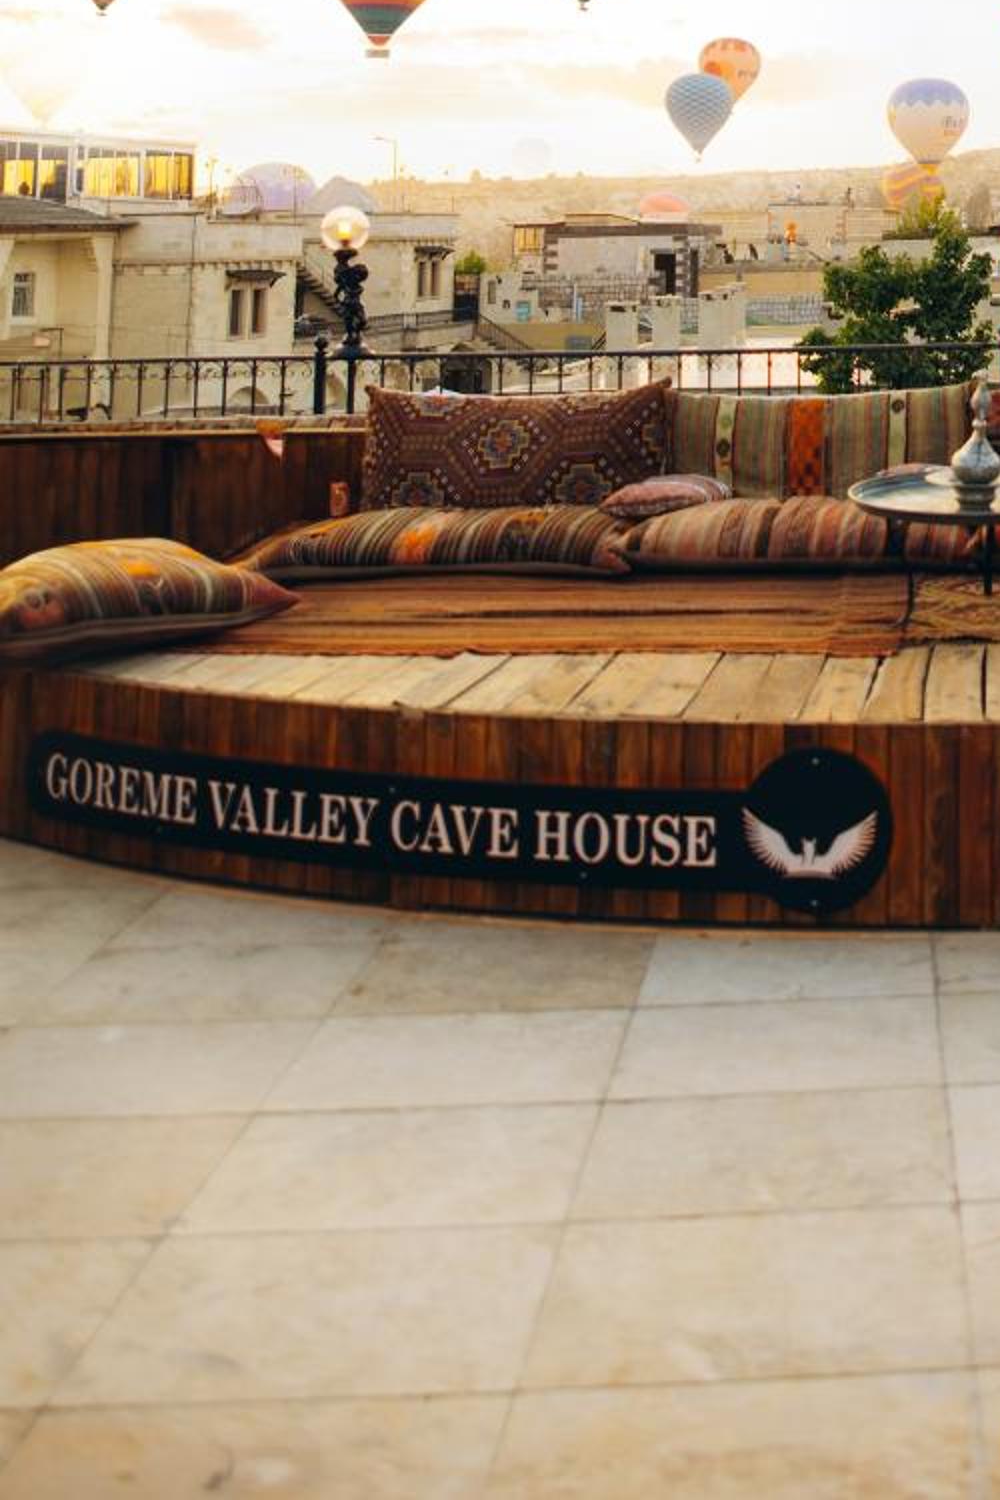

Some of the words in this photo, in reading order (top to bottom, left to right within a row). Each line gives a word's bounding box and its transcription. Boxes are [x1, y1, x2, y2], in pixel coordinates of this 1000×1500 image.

[46, 752, 198, 825] GOREME
[207, 778, 379, 847] VALLEY
[390, 800, 519, 858] CAVE
[534, 809, 717, 868] HOUSE
